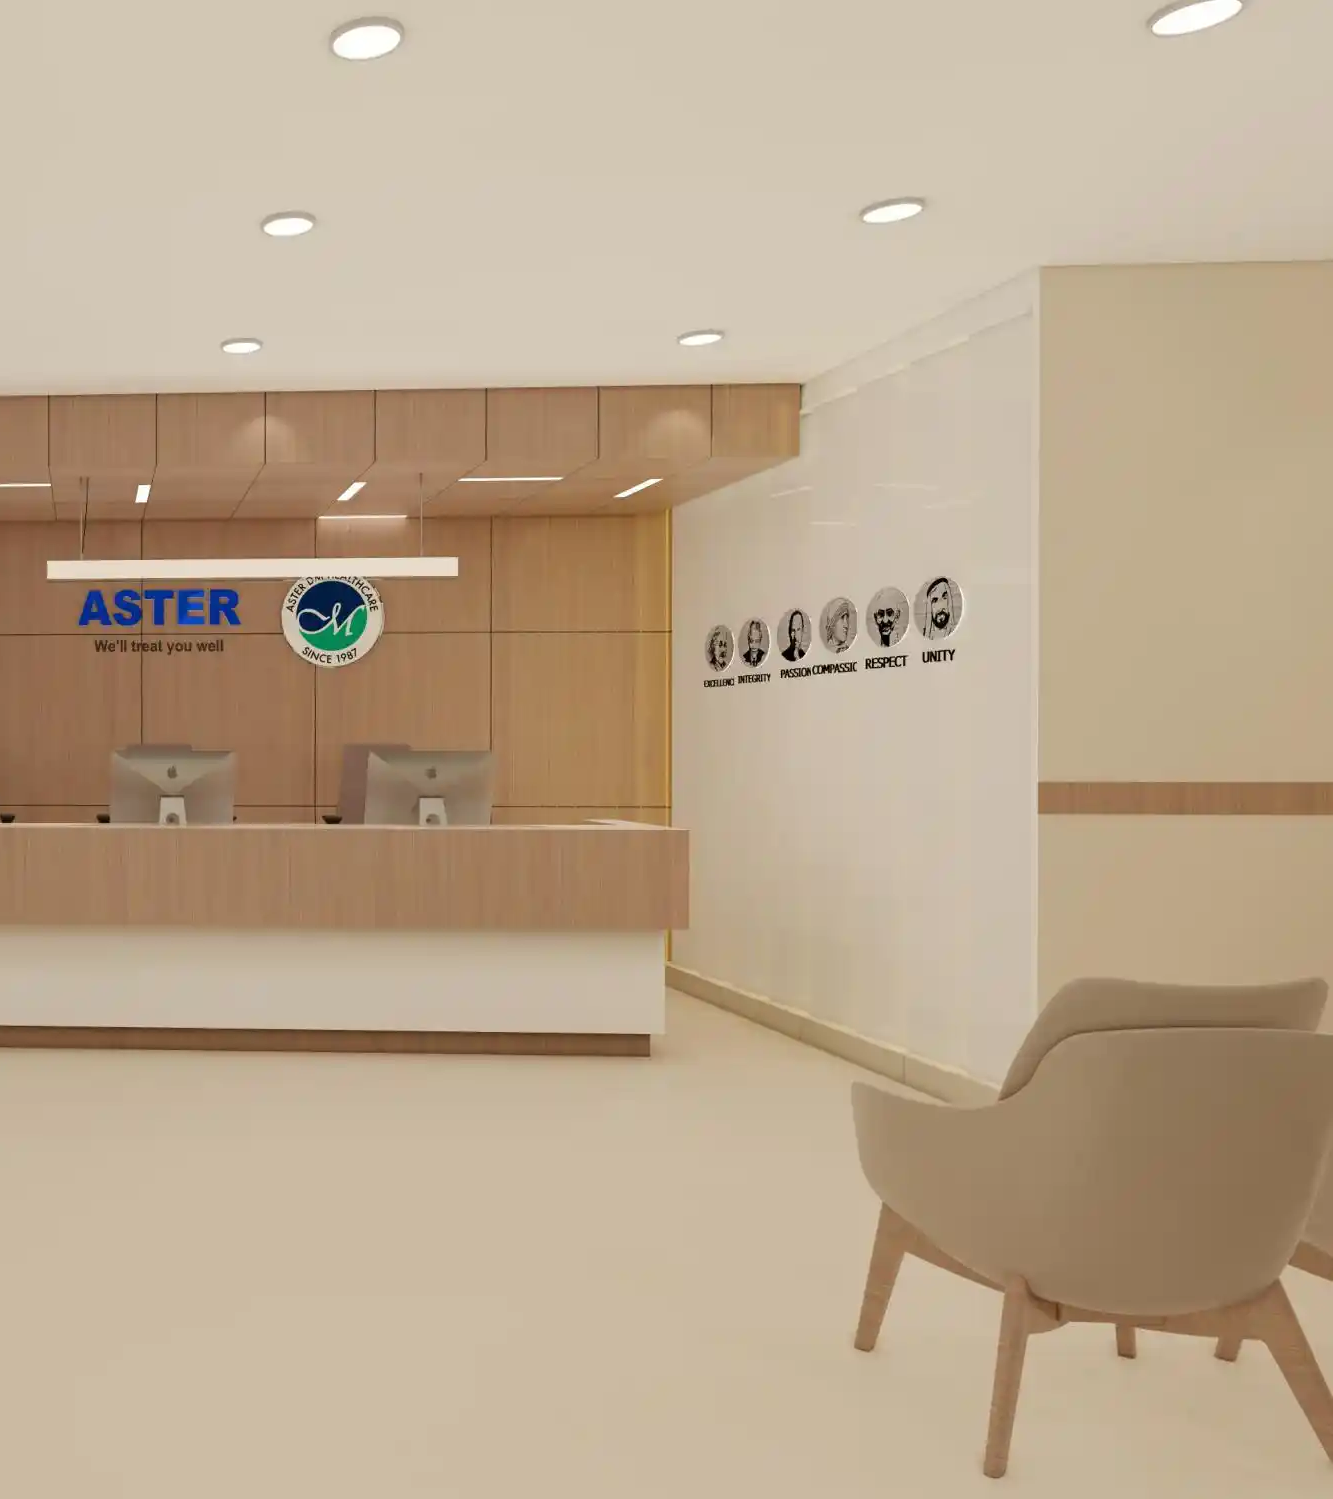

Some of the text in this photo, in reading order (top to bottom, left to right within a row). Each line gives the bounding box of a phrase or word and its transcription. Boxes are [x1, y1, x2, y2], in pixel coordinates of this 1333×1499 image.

[286, 583, 307, 612] ASTER
[78, 589, 241, 626] ASTER
[95, 640, 224, 655] We'll treat you well
[302, 647, 357, 663] SINCE 1987
[865, 655, 909, 669] RESPECT
[922, 649, 956, 663] UNITY
[737, 673, 771, 684] INTEGRITY
[780, 667, 812, 678] PASSION
